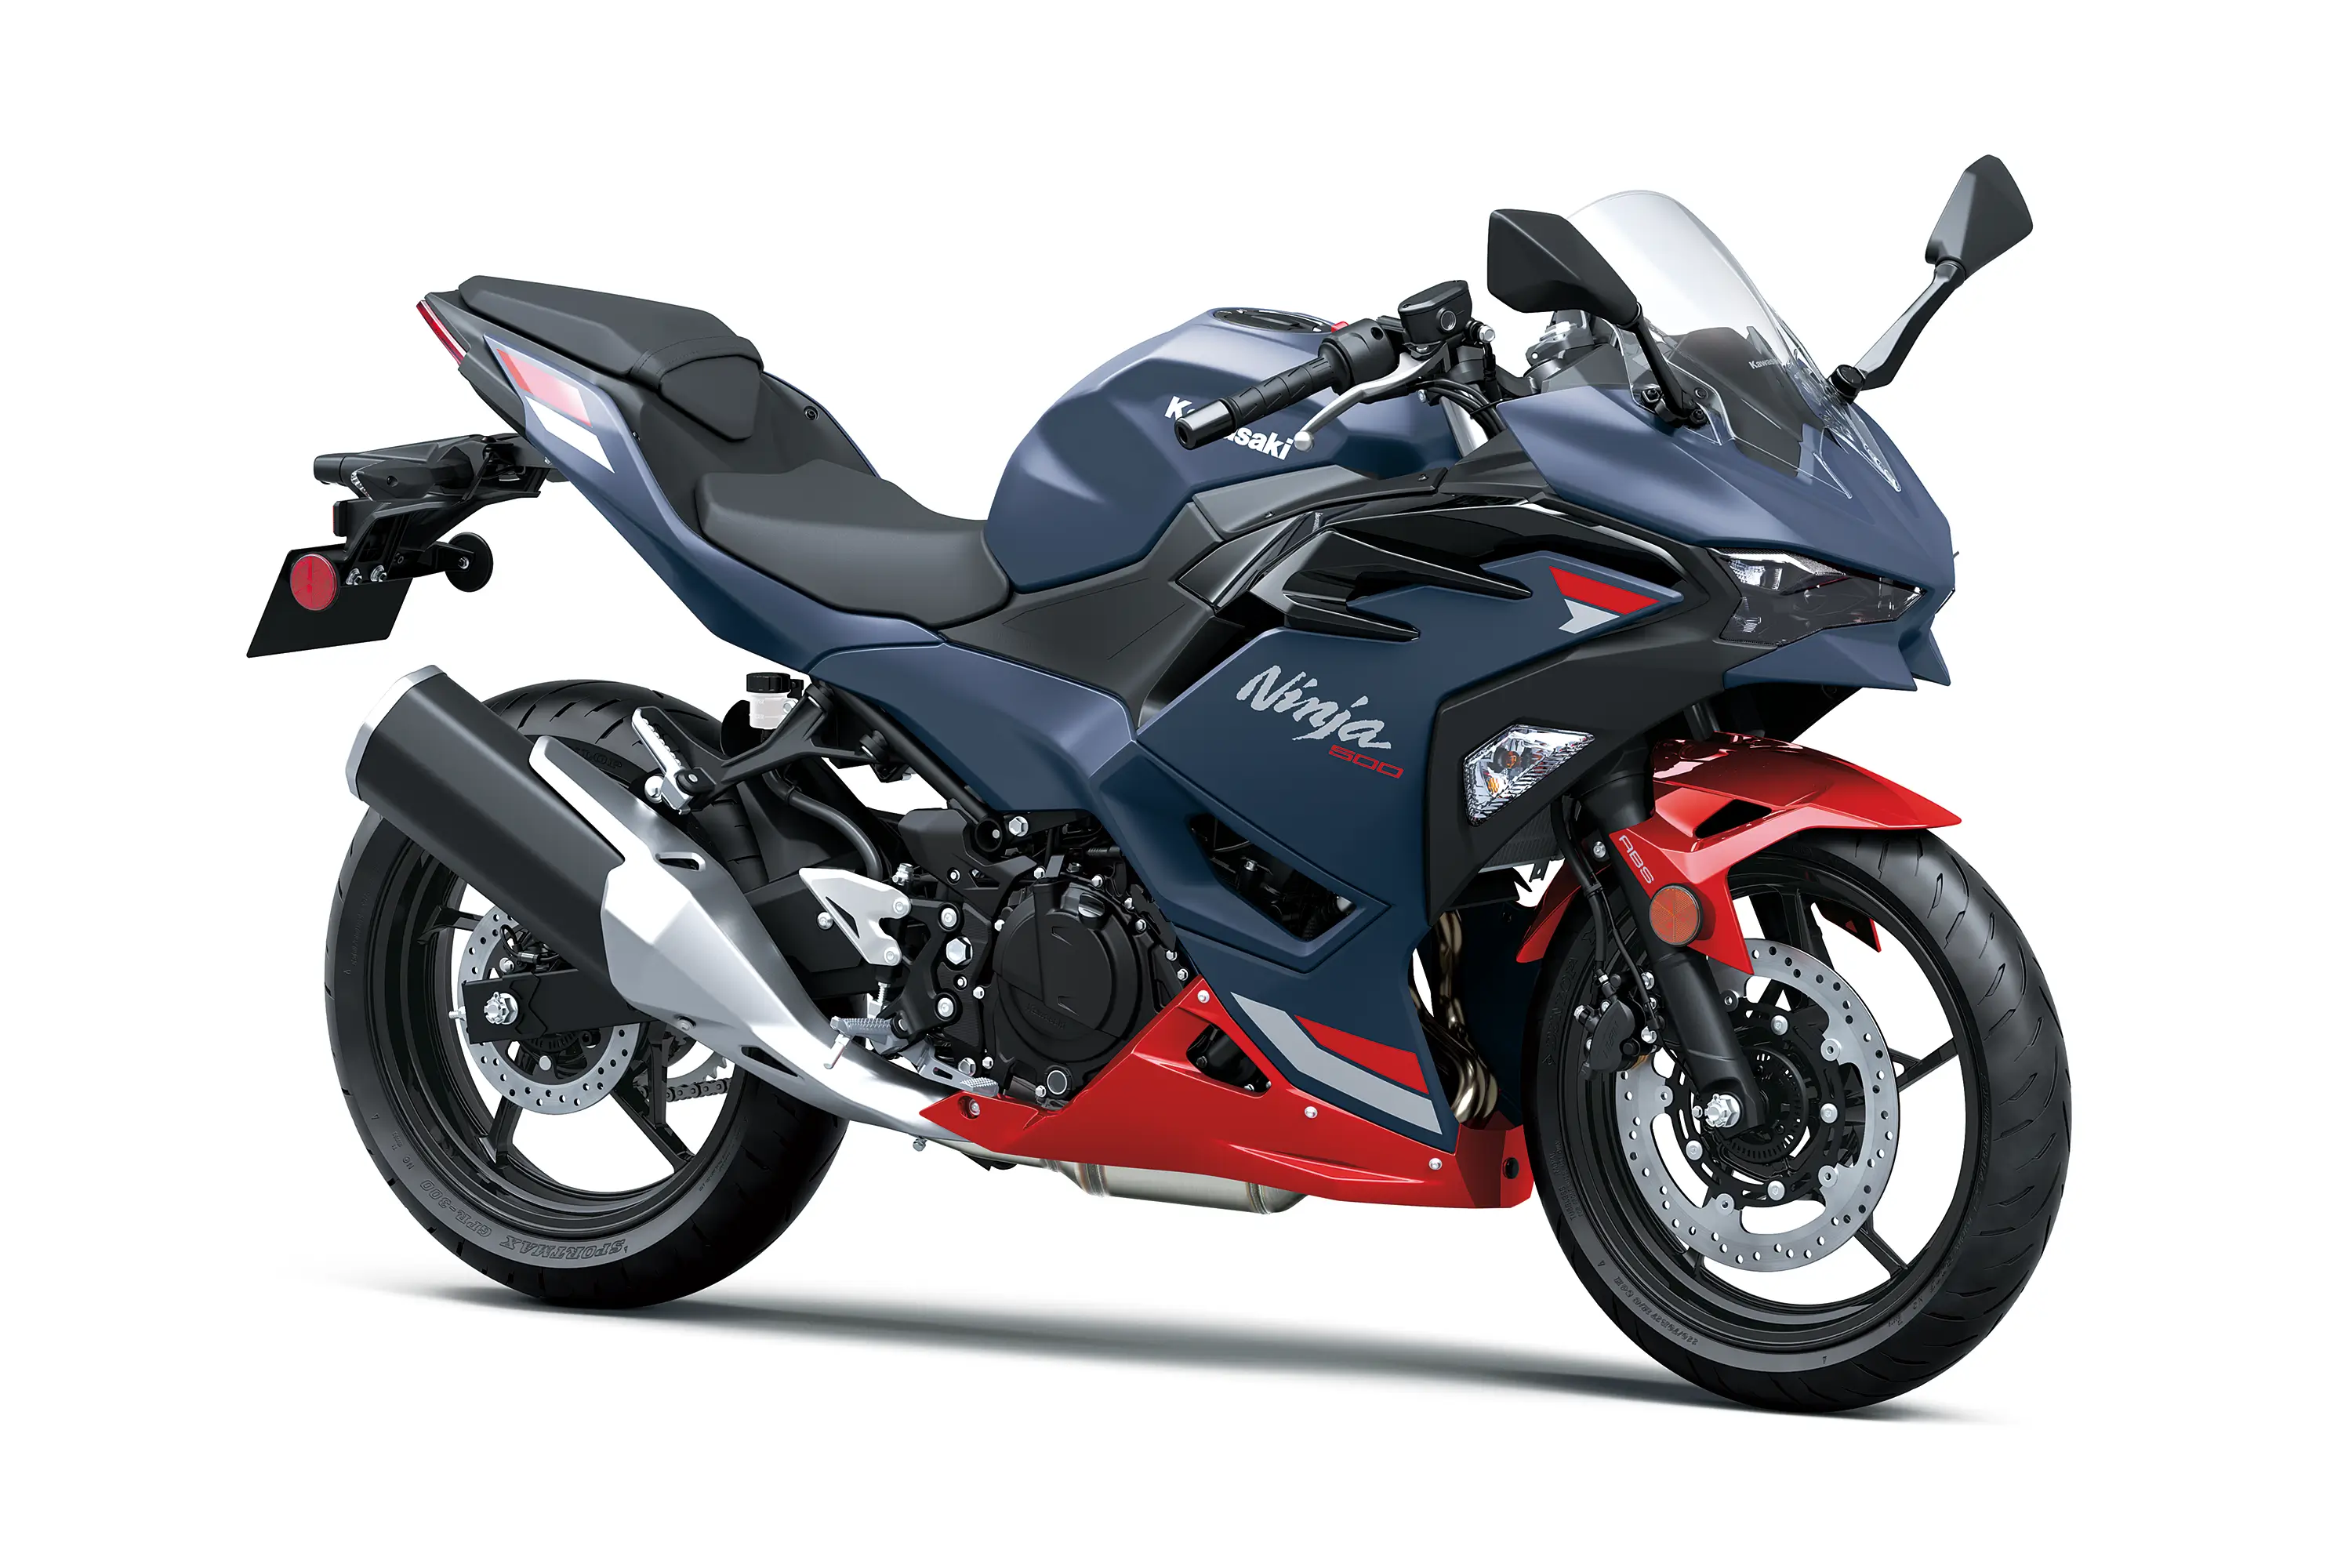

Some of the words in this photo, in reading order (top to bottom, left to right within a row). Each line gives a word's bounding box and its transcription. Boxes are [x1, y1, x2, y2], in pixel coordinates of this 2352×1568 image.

[1236, 665, 1392, 750] Ninja
[1328, 744, 1404, 779] 500
[1618, 835, 1655, 884] ABS
[419, 1179, 492, 1238] GPR-300
[499, 1234, 626, 1260] SPORTMAX
